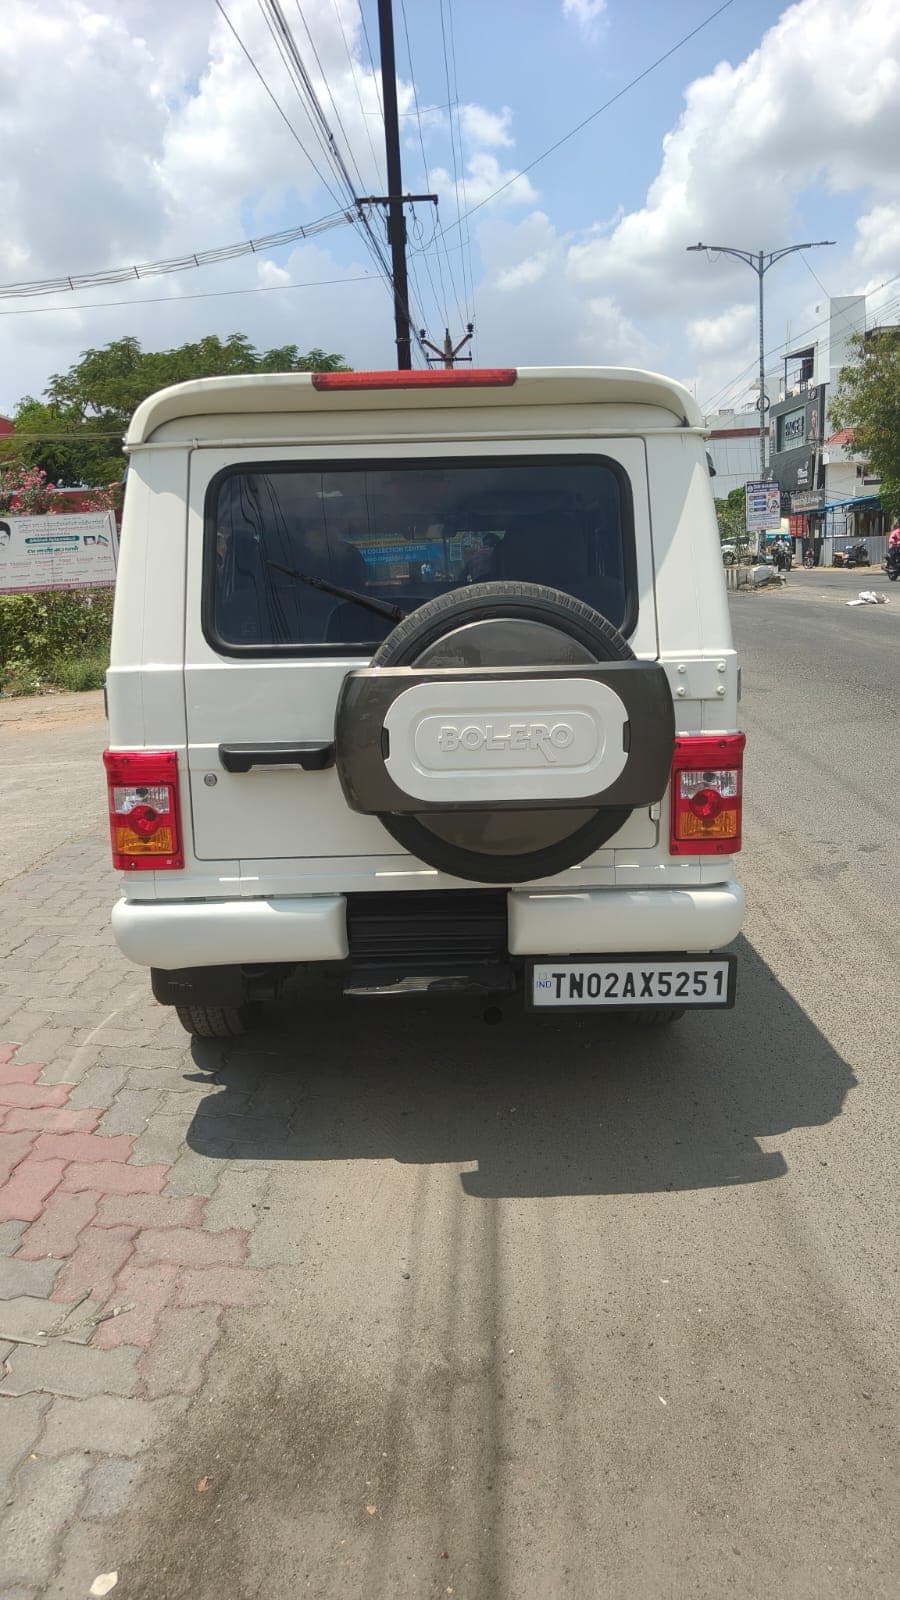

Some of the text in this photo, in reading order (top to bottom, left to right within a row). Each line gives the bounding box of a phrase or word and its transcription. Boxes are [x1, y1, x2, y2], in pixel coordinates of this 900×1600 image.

[367, 546, 403, 554] COLLECTION
[438, 723, 575, 762] BOLERO
[536, 970, 723, 998] IND TN02AX5251
